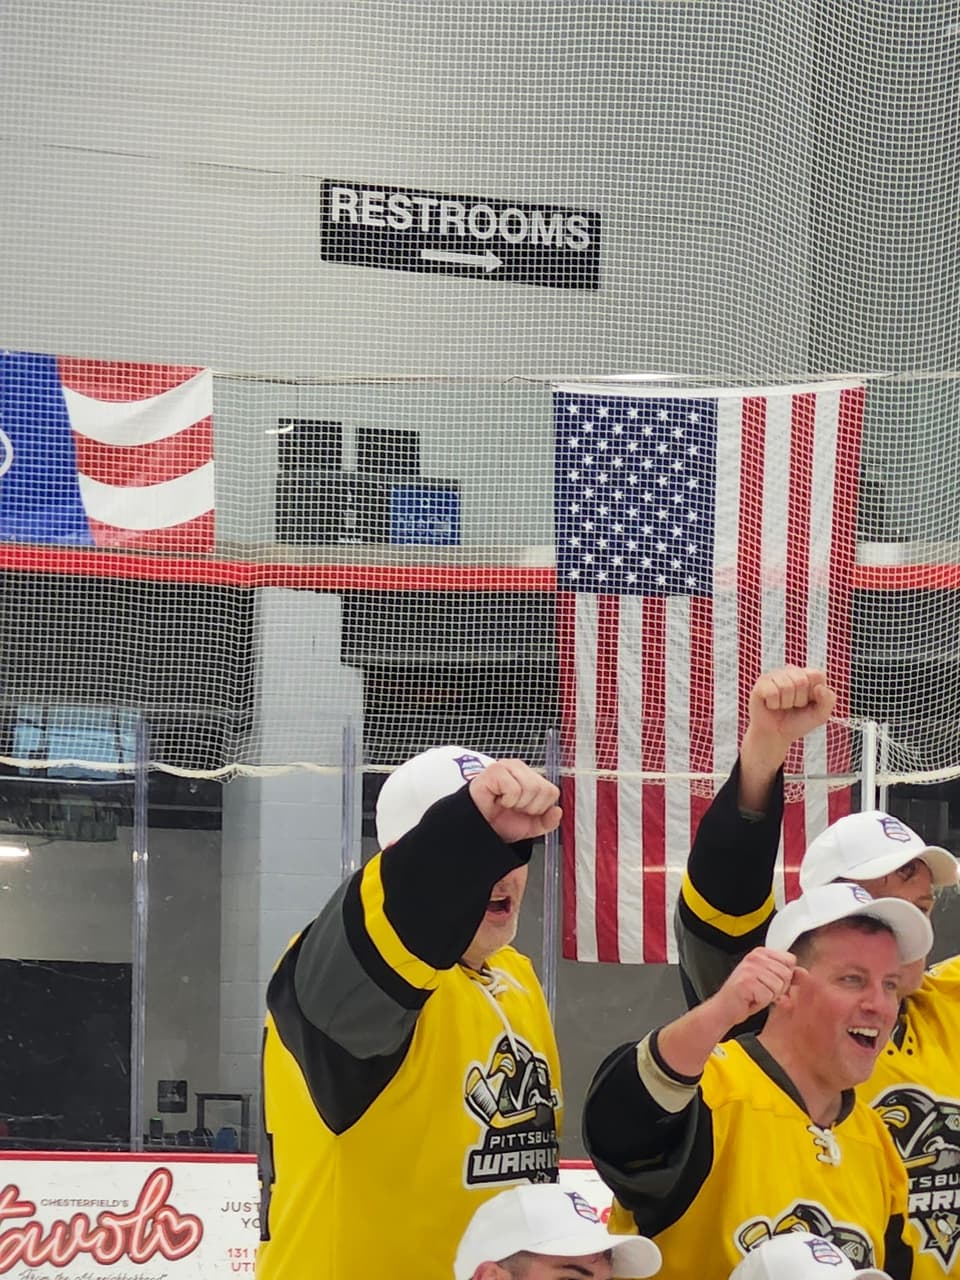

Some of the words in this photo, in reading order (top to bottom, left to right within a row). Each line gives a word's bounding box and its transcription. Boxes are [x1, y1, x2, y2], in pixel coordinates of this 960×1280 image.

[331, 186, 591, 250] RESTROOMS
[490, 1131, 556, 1149] PITTSBU
[472, 1149, 558, 1177] WARRI
[227, 1247, 249, 1258] 131
[231, 1262, 256, 1272] UTI
